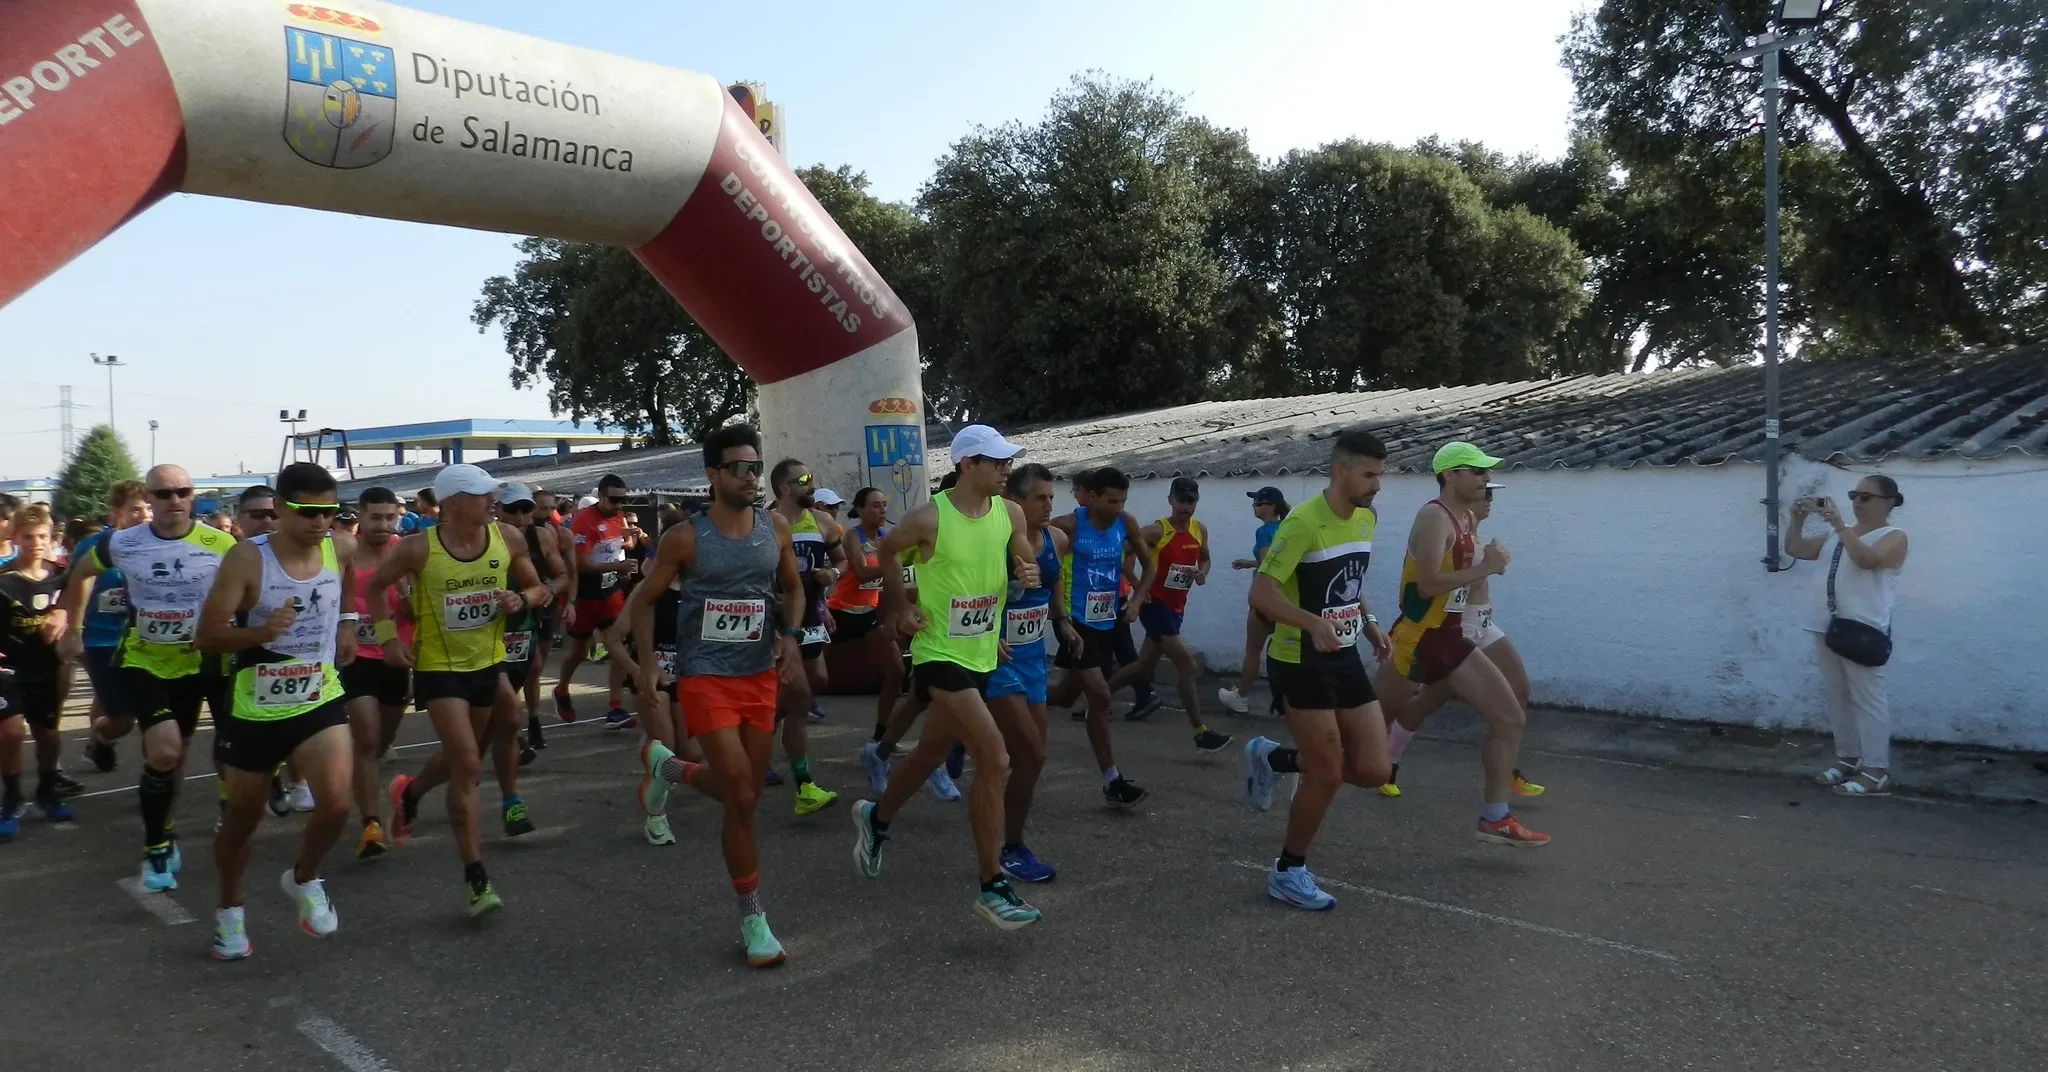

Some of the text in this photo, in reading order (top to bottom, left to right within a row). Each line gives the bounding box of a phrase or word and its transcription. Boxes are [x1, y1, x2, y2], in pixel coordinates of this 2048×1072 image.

[412, 52, 600, 115] Diputación
[412, 116, 633, 172] de Salamanca
[720, 172, 861, 333] DEPORTISTAS
[482, 576, 498, 585] GO
[458, 603, 491, 621] 603
[706, 601, 764, 614] bedunia
[961, 607, 989, 626] 644
[148, 621, 182, 634] 672
[716, 614, 751, 631] 671
[1018, 620, 1041, 635] 601
[270, 676, 311, 694] 687
